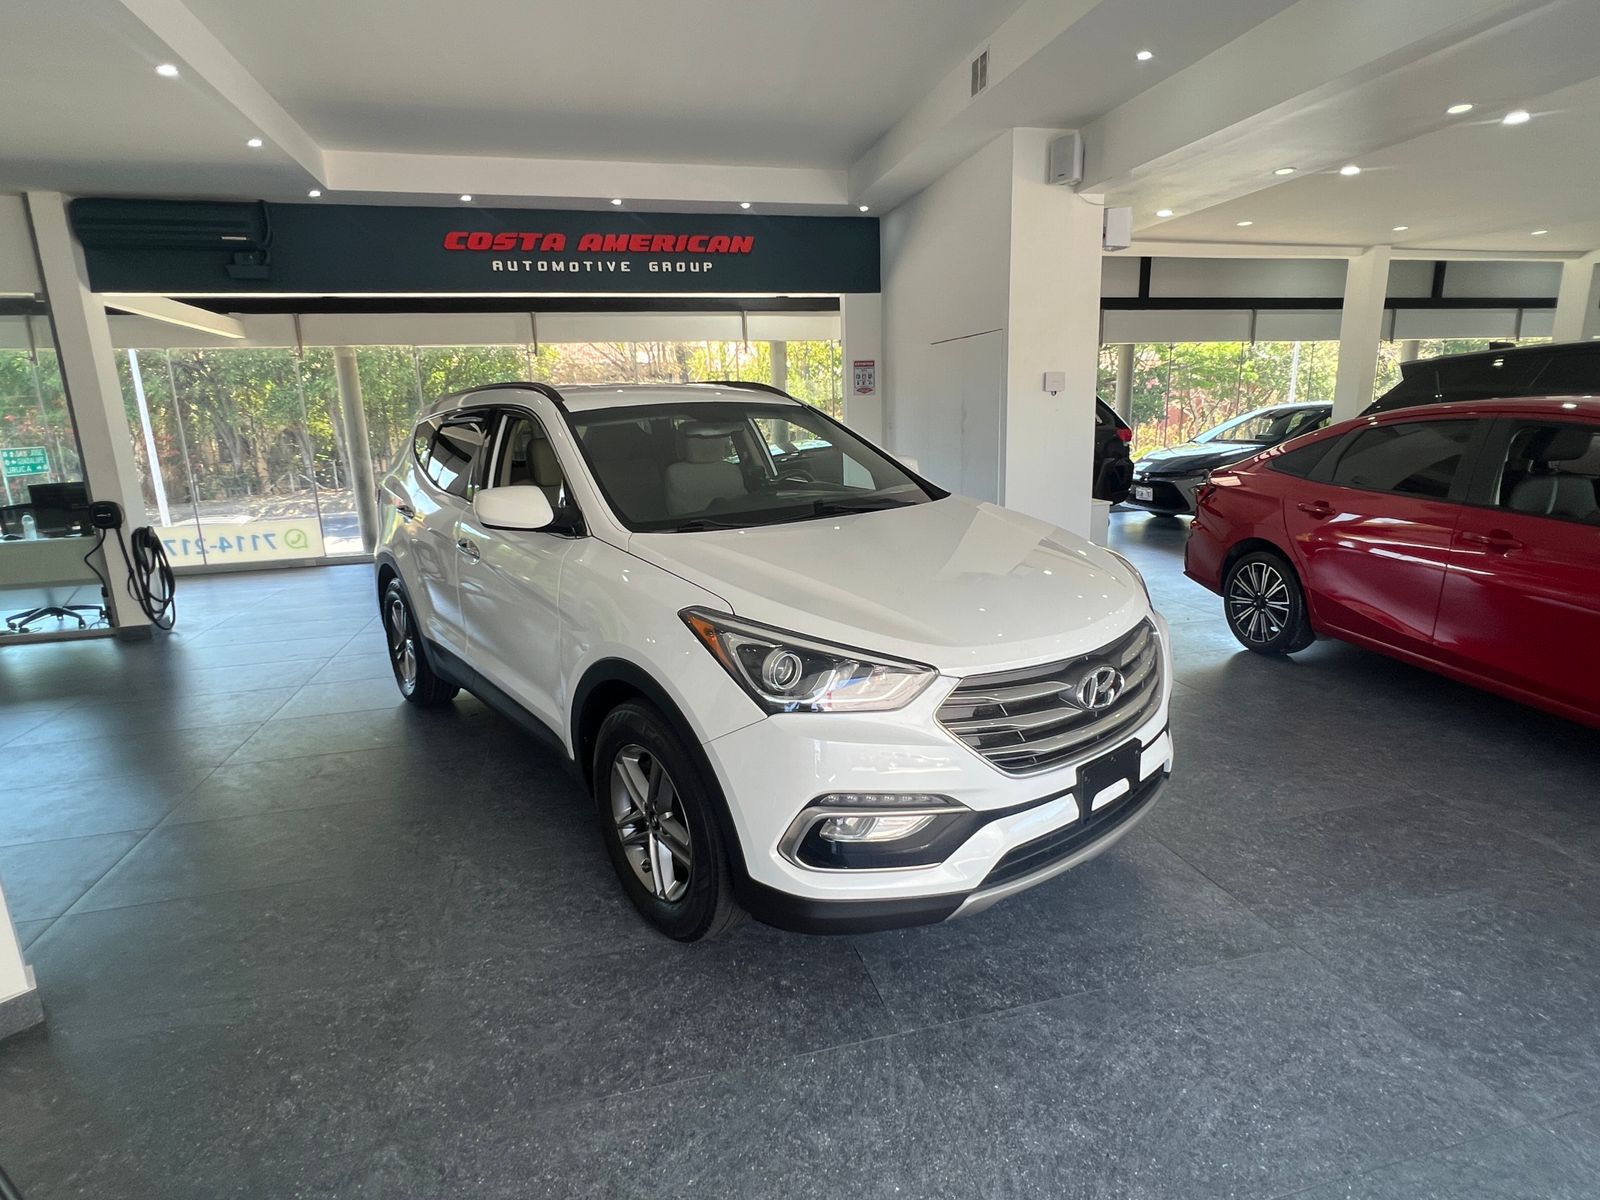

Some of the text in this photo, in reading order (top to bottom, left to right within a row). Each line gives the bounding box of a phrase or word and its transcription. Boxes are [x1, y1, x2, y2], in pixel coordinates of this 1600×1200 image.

[444, 231, 755, 254] COSTA AMERICAN
[492, 260, 713, 273] AUTOMOTIVE GROUP
